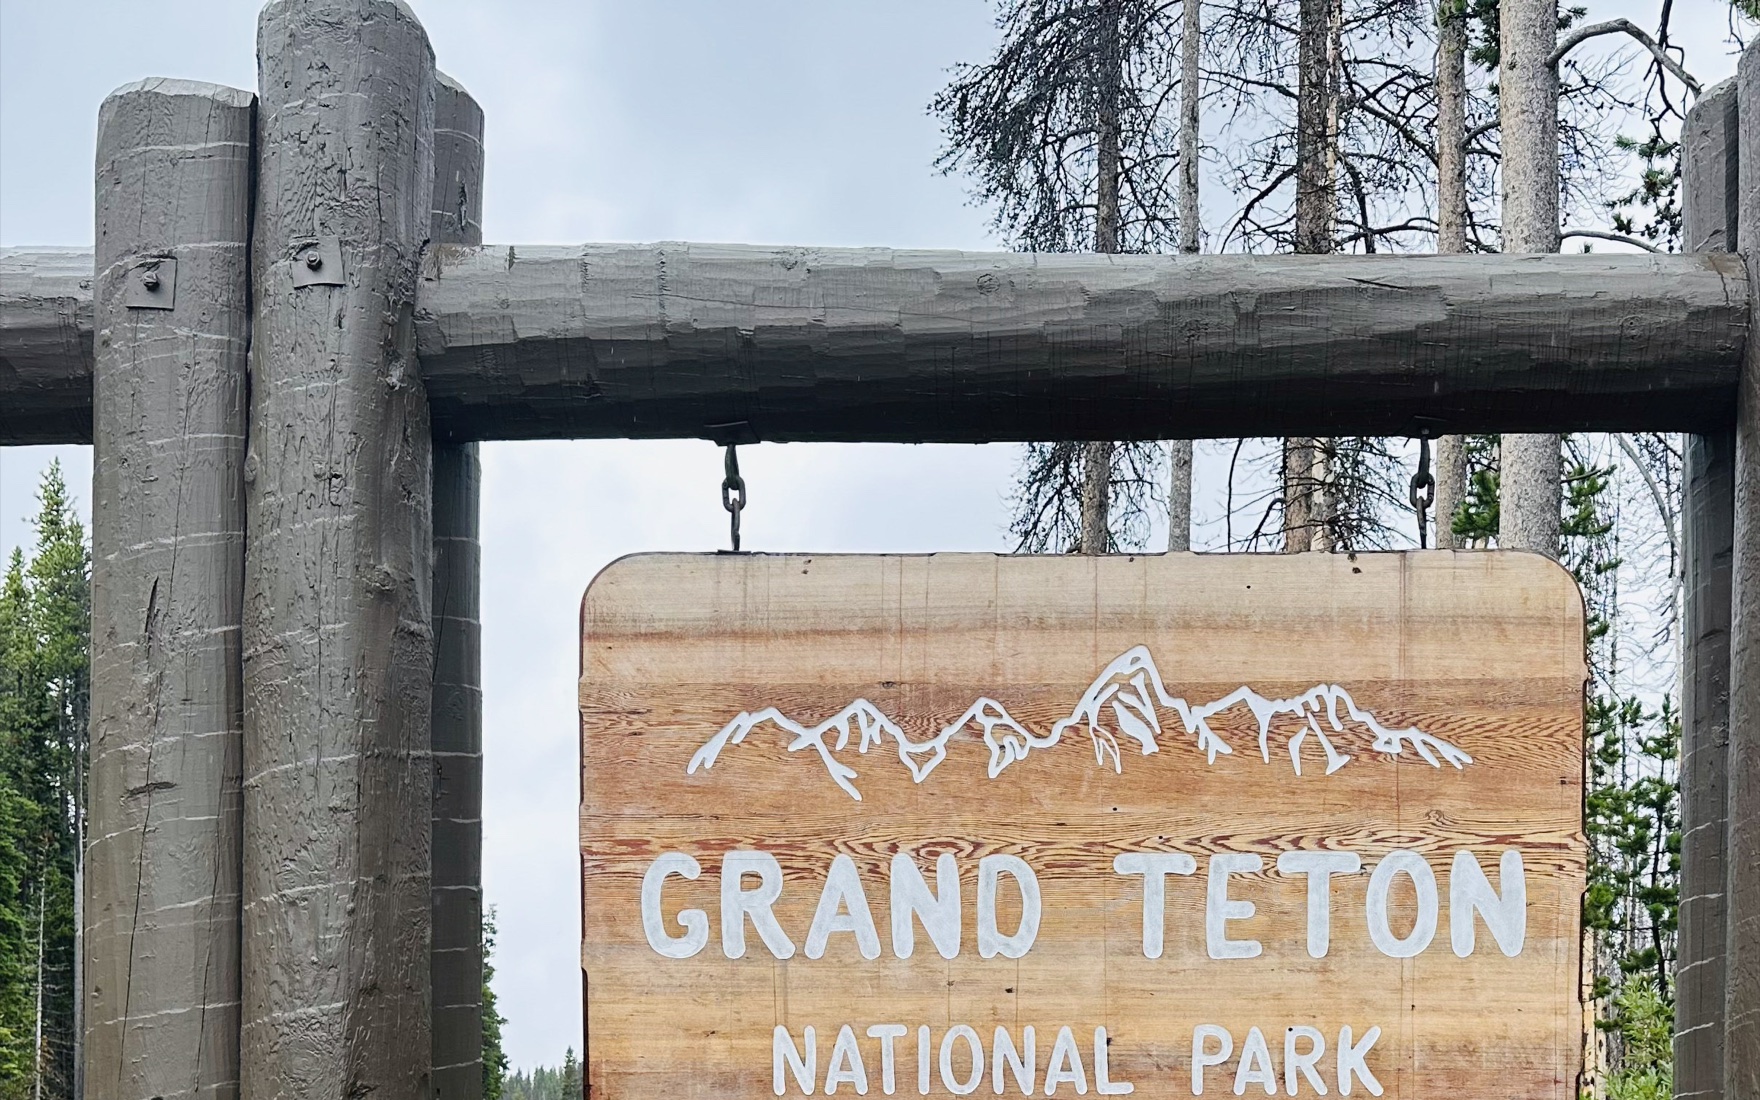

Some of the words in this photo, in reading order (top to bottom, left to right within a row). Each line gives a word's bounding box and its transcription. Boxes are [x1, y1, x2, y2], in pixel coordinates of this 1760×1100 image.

[640, 850, 1042, 960] GRAND
[1113, 850, 1527, 959] TETON
[772, 1023, 1135, 1097] NATIONAL
[1191, 1023, 1385, 1097] PARK
